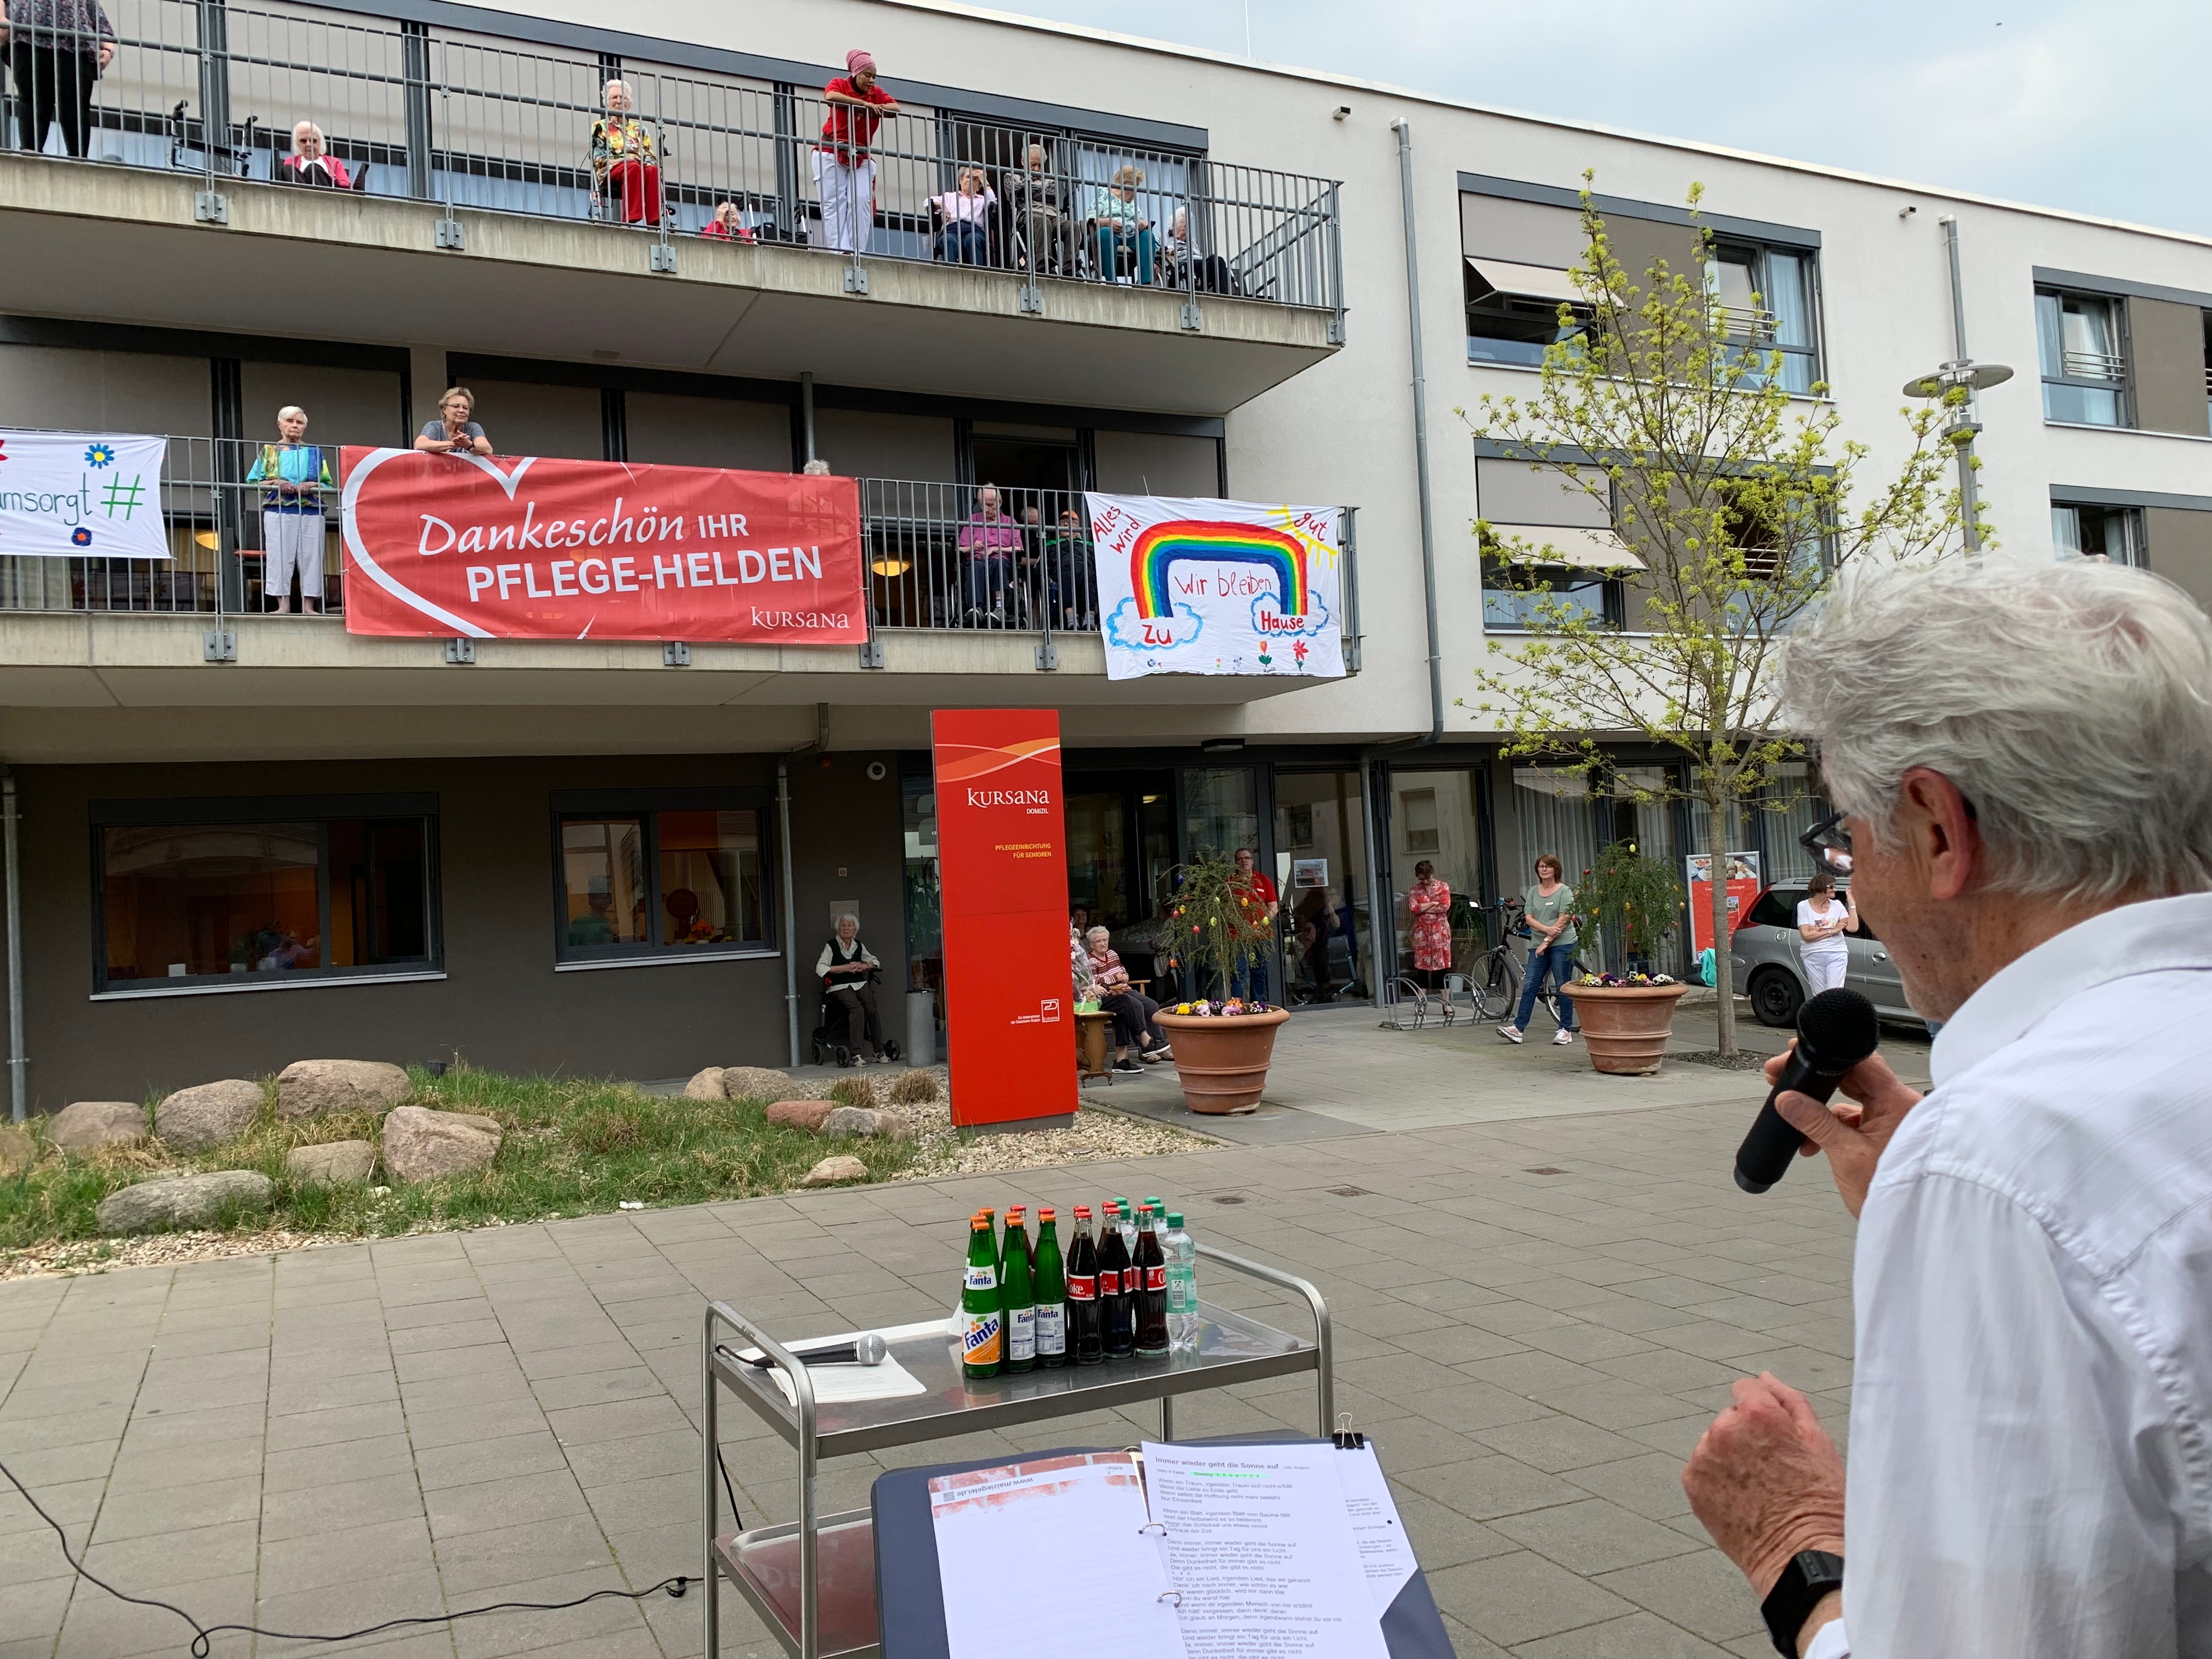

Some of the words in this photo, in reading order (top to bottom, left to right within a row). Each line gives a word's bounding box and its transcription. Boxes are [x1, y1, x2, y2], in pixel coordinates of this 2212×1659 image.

[0, 472, 92, 526] msorgt
[419, 496, 684, 556] Dankeschön
[698, 514, 750, 539] IHR
[1092, 505, 1121, 543] Alles
[1294, 512, 1328, 541] gut
[466, 545, 823, 603] PFLEGE-HELDEN
[1174, 573, 1208, 595] Wir
[1217, 568, 1272, 597] bleiben
[1261, 610, 1305, 631] Hause
[995, 843, 1051, 851] PFLEGEEINRICHTUNG
[970, 1275, 991, 1285] Fanta
[1018, 1314, 1034, 1323] Fanta
[1038, 1309, 1058, 1318] Fanta
[964, 1318, 998, 1350] Fanta
[1155, 1456, 1179, 1464] Immer
